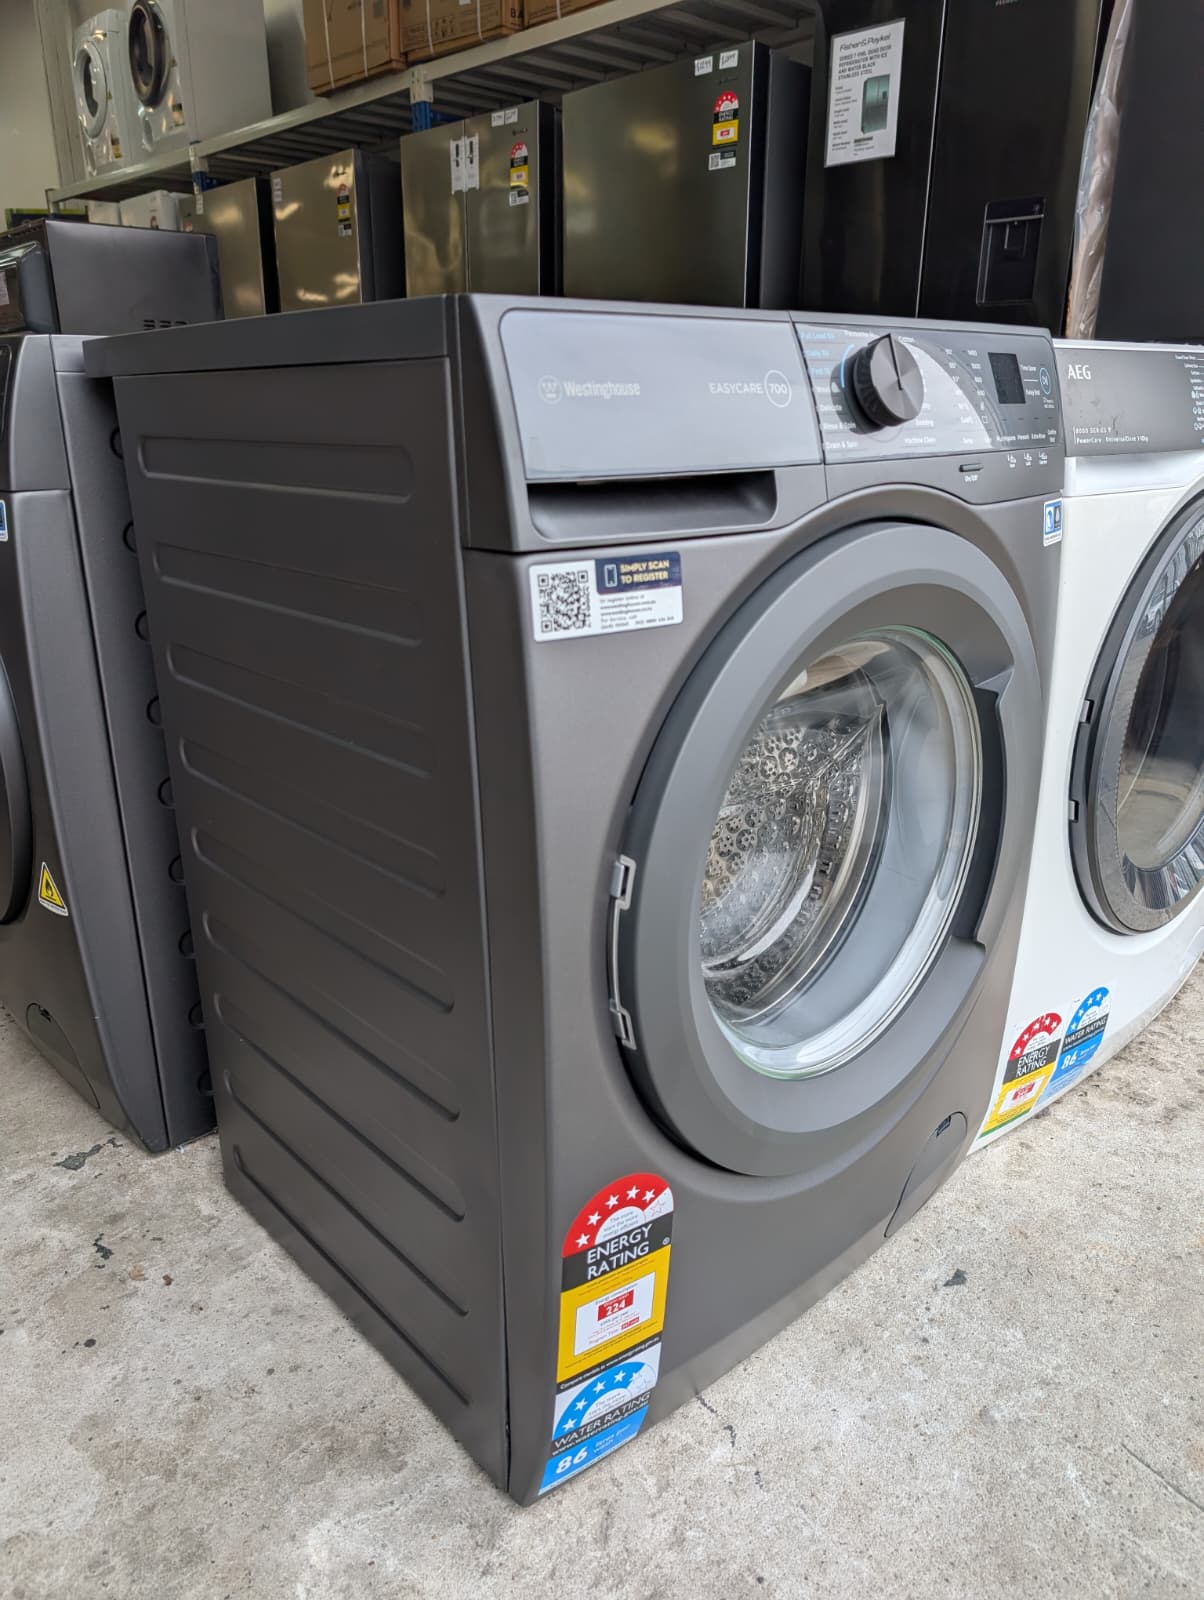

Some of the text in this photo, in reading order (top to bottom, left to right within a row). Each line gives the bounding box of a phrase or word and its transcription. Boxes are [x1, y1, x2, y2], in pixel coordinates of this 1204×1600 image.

[1067, 364, 1092, 380] AEG
[564, 381, 640, 399] Westinghouse
[710, 383, 787, 394] EASYCARE 700
[620, 560, 669, 573] SIMPLY SCAN
[621, 571, 669, 584] TO REGISTER
[1064, 1029, 1084, 1044] WATER
[1083, 1017, 1107, 1034] RATING
[1017, 1045, 1050, 1067] ENERGY
[1016, 1055, 1048, 1078] RATING
[587, 1223, 652, 1264] ENERGY
[588, 1241, 650, 1280] RATING
[606, 1300, 626, 1316] 224
[560, 1376, 583, 1390] Compare
[554, 1420, 602, 1449] WATER
[603, 1391, 650, 1423] RATING
[556, 1446, 588, 1474] 86
